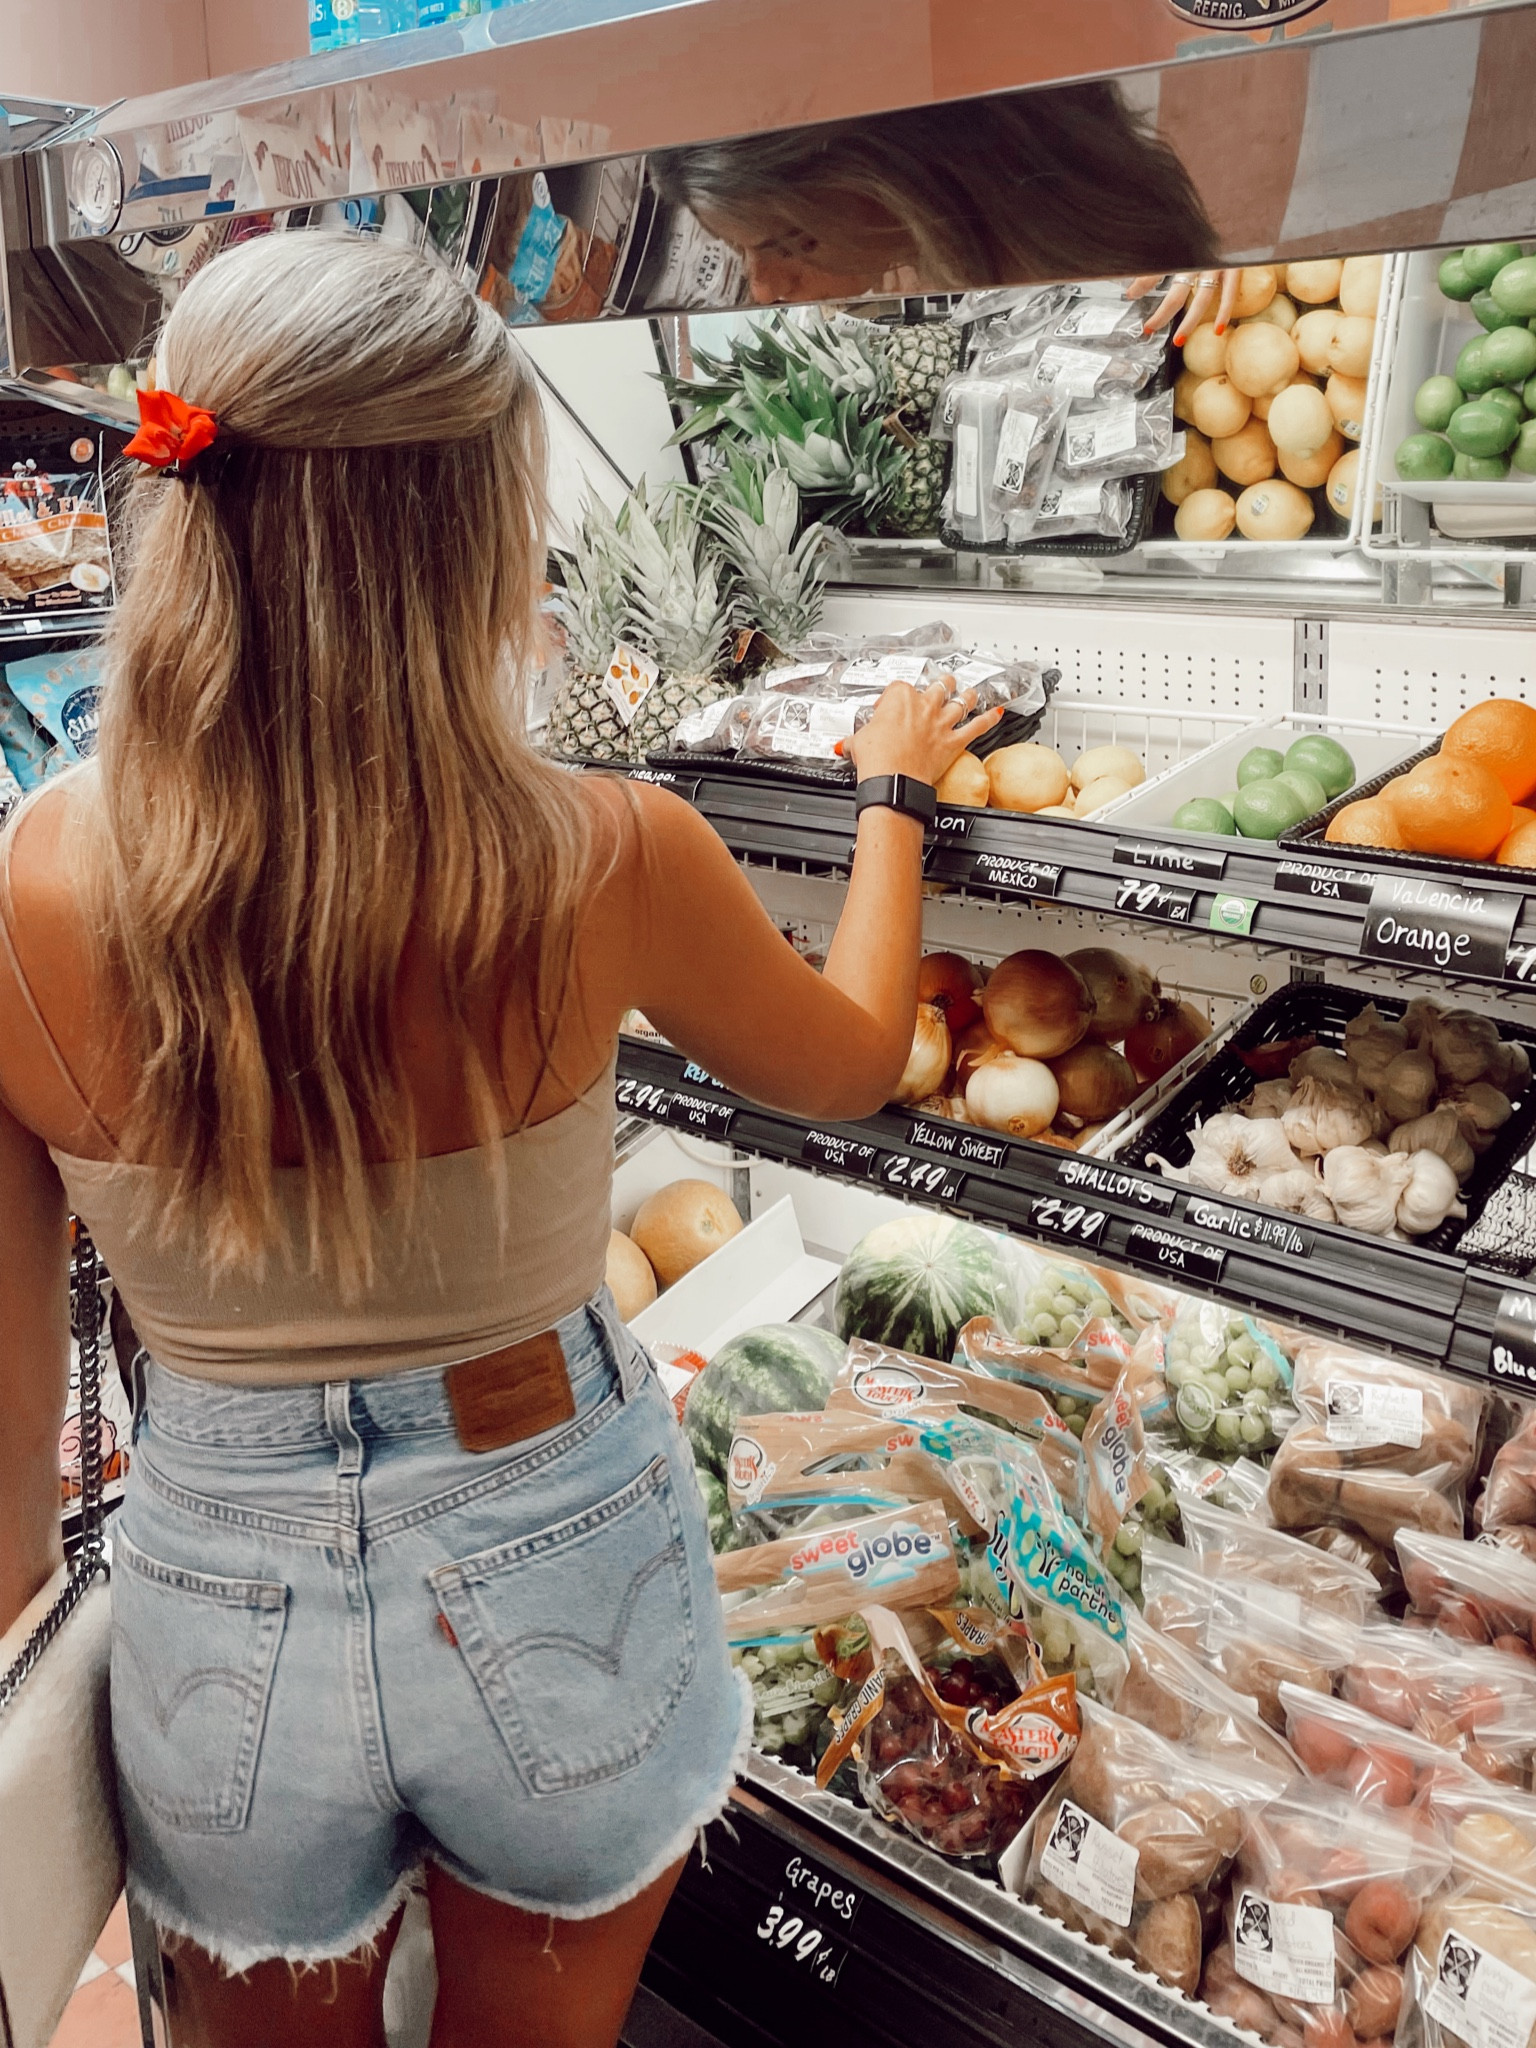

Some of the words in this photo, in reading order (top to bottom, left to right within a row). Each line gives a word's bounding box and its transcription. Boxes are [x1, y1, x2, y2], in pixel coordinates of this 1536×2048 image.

[976, 854, 1037, 874] PRODUCT
[1041, 864, 1061, 876] OF
[1133, 844, 1195, 871] Lime
[988, 871, 1038, 890] MEXICO
[1279, 860, 1356, 882] PRODUCT
[1360, 873, 1377, 887] OF
[1310, 880, 1340, 898] USA
[1392, 880, 1487, 914] Valencia
[1170, 906, 1188, 920] EA
[1376, 917, 1471, 966] Orange
[672, 1092, 719, 1114] PRODUCT
[719, 1106, 734, 1118] OF
[689, 1110, 707, 1126] USA
[806, 1130, 858, 1153] PRODUCT
[859, 1145, 875, 1157] OF
[911, 1121, 957, 1151] YELLOW
[959, 1137, 1002, 1165] SWEET
[824, 1149, 845, 1166] USA
[941, 1184, 955, 1198] LB
[1064, 1161, 1154, 1204] SHALLOTS
[1131, 1224, 1201, 1253] PRODUCT
[1203, 1246, 1225, 1260] OF
[1193, 1204, 1251, 1238] Garlic
[1254, 1216, 1303, 1253] $11.99/lb
[1158, 1247, 1185, 1268] USA
[1508, 1296, 1536, 1320] M
[1101, 1426, 1131, 1496] globe
[791, 1531, 859, 1570] sweet
[847, 1531, 932, 1577] globe
[786, 1857, 855, 1919] Grapes
[820, 1965, 836, 1982] LB
